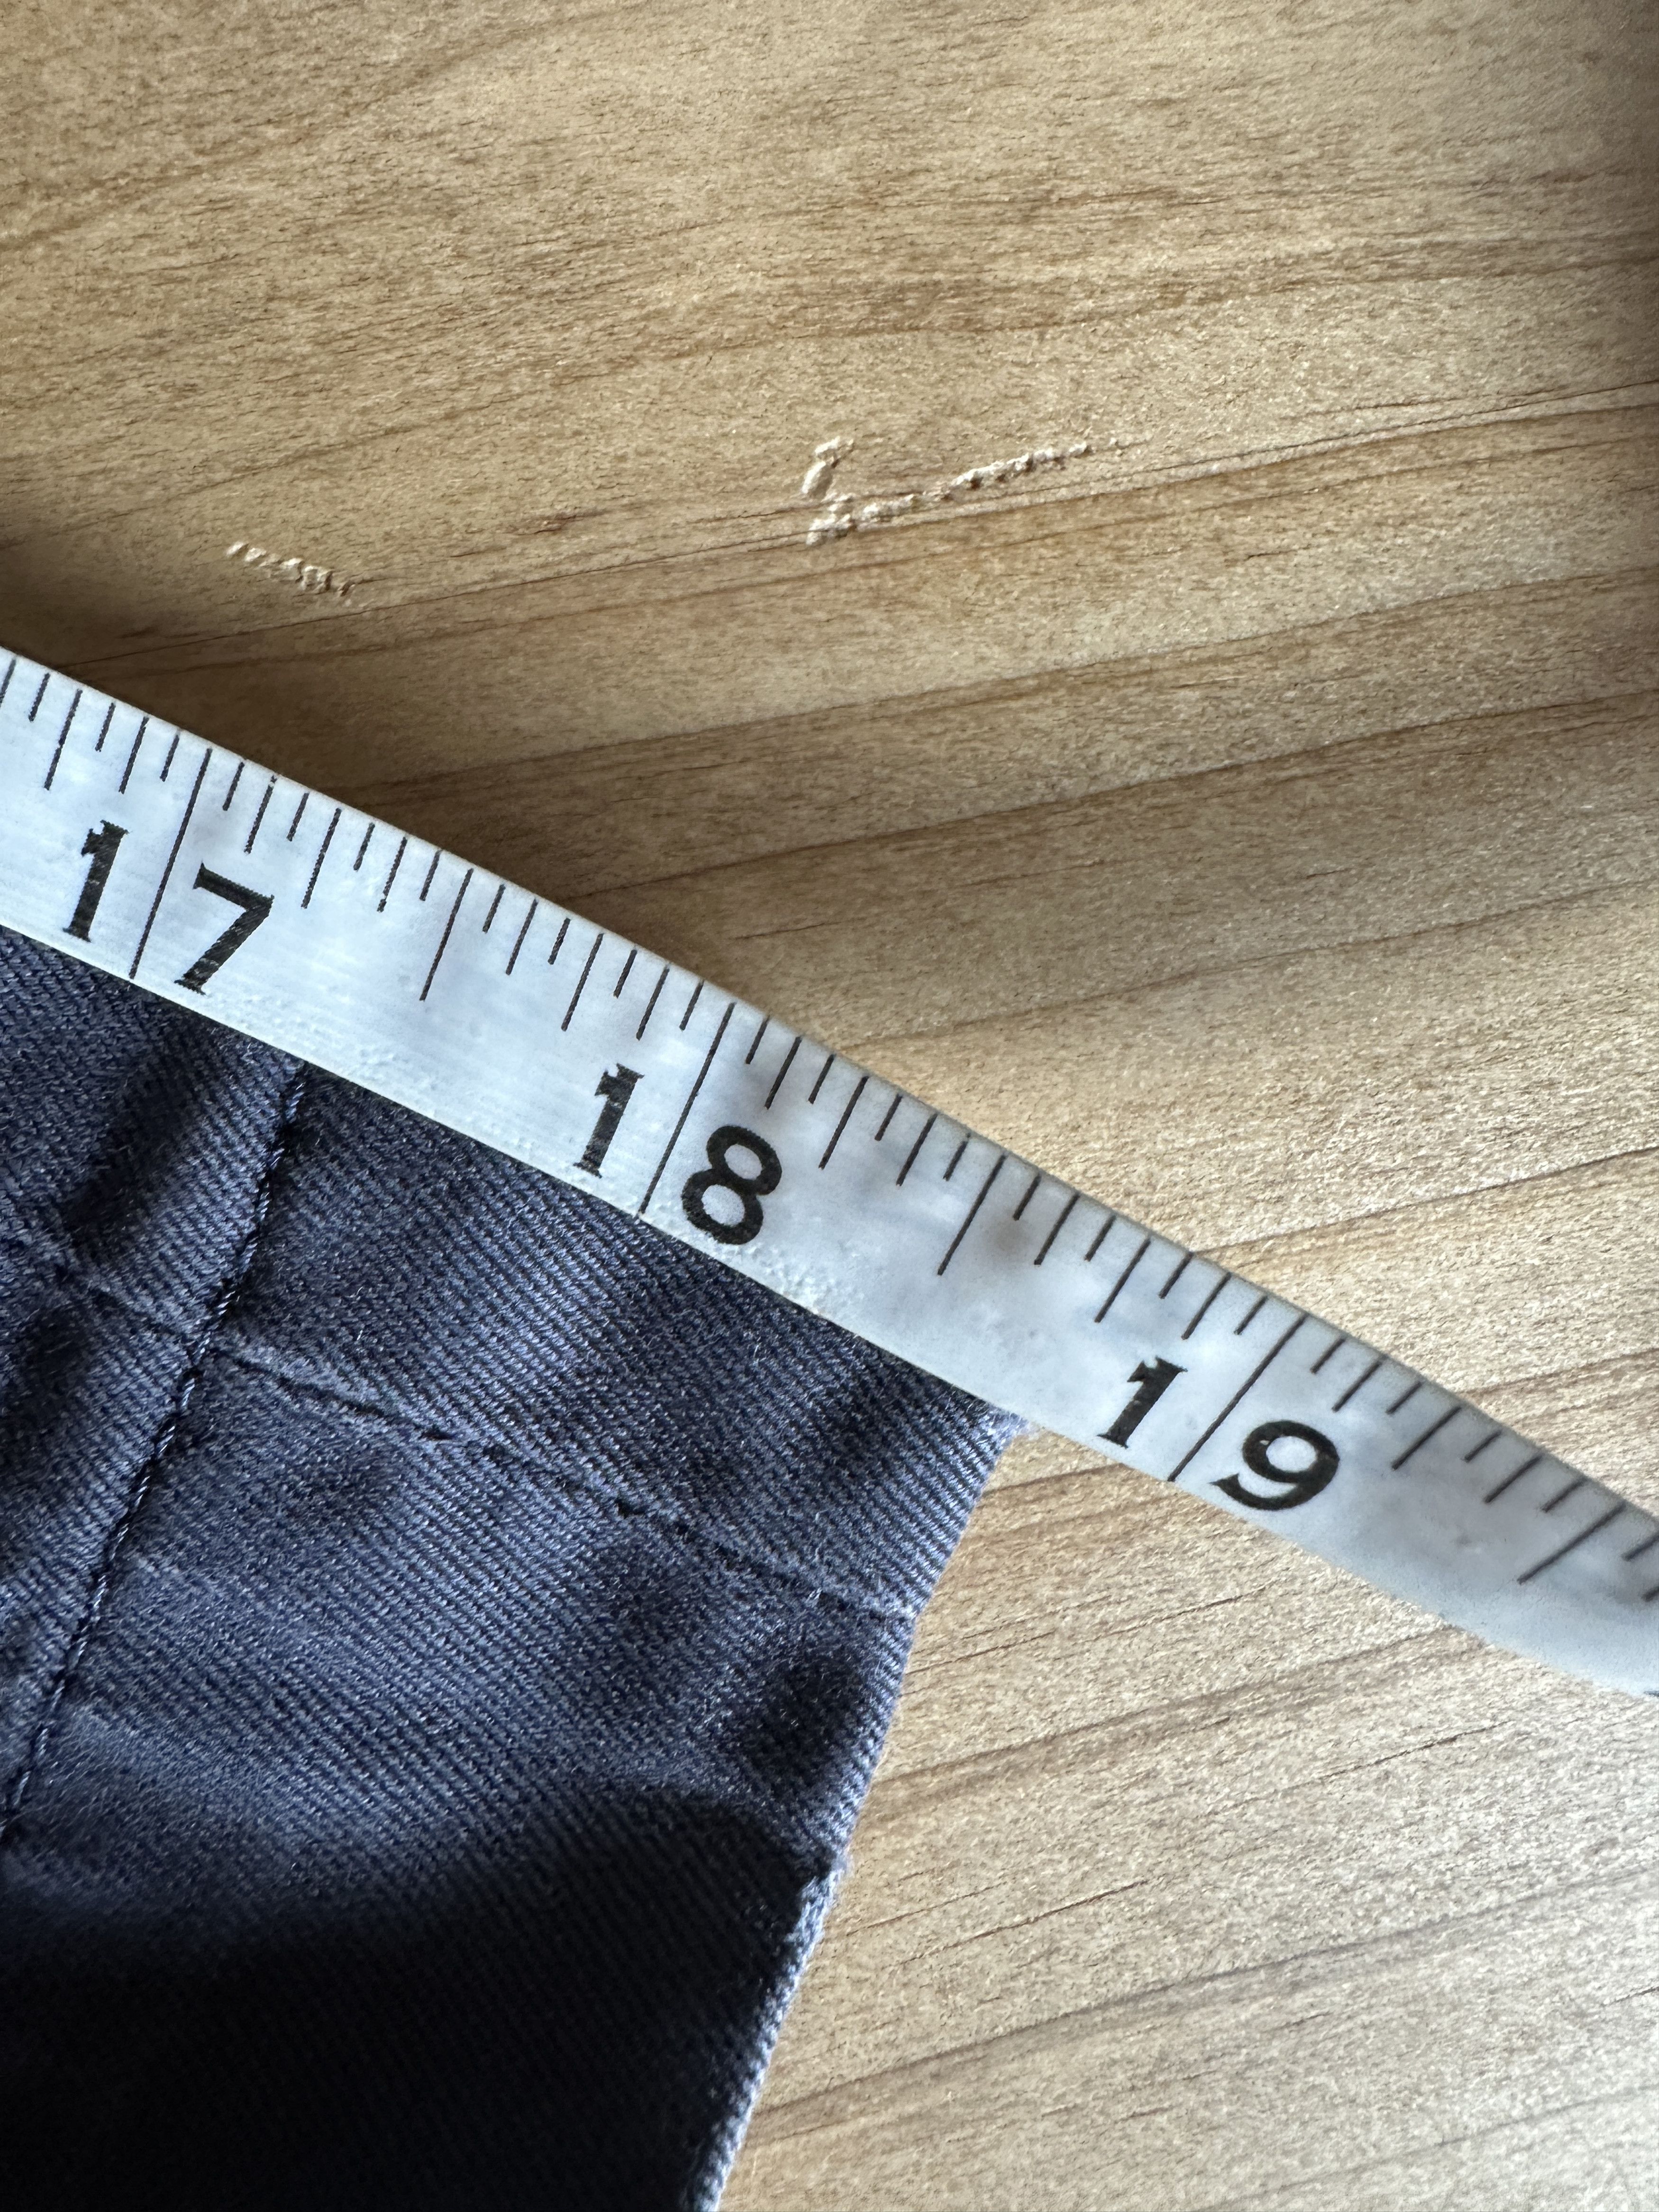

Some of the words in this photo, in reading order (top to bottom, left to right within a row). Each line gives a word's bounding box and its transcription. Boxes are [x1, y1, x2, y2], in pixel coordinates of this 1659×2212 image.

[62, 819, 275, 995] 17
[573, 1063, 783, 1246] 18
[1096, 1356, 1340, 1511] 19
